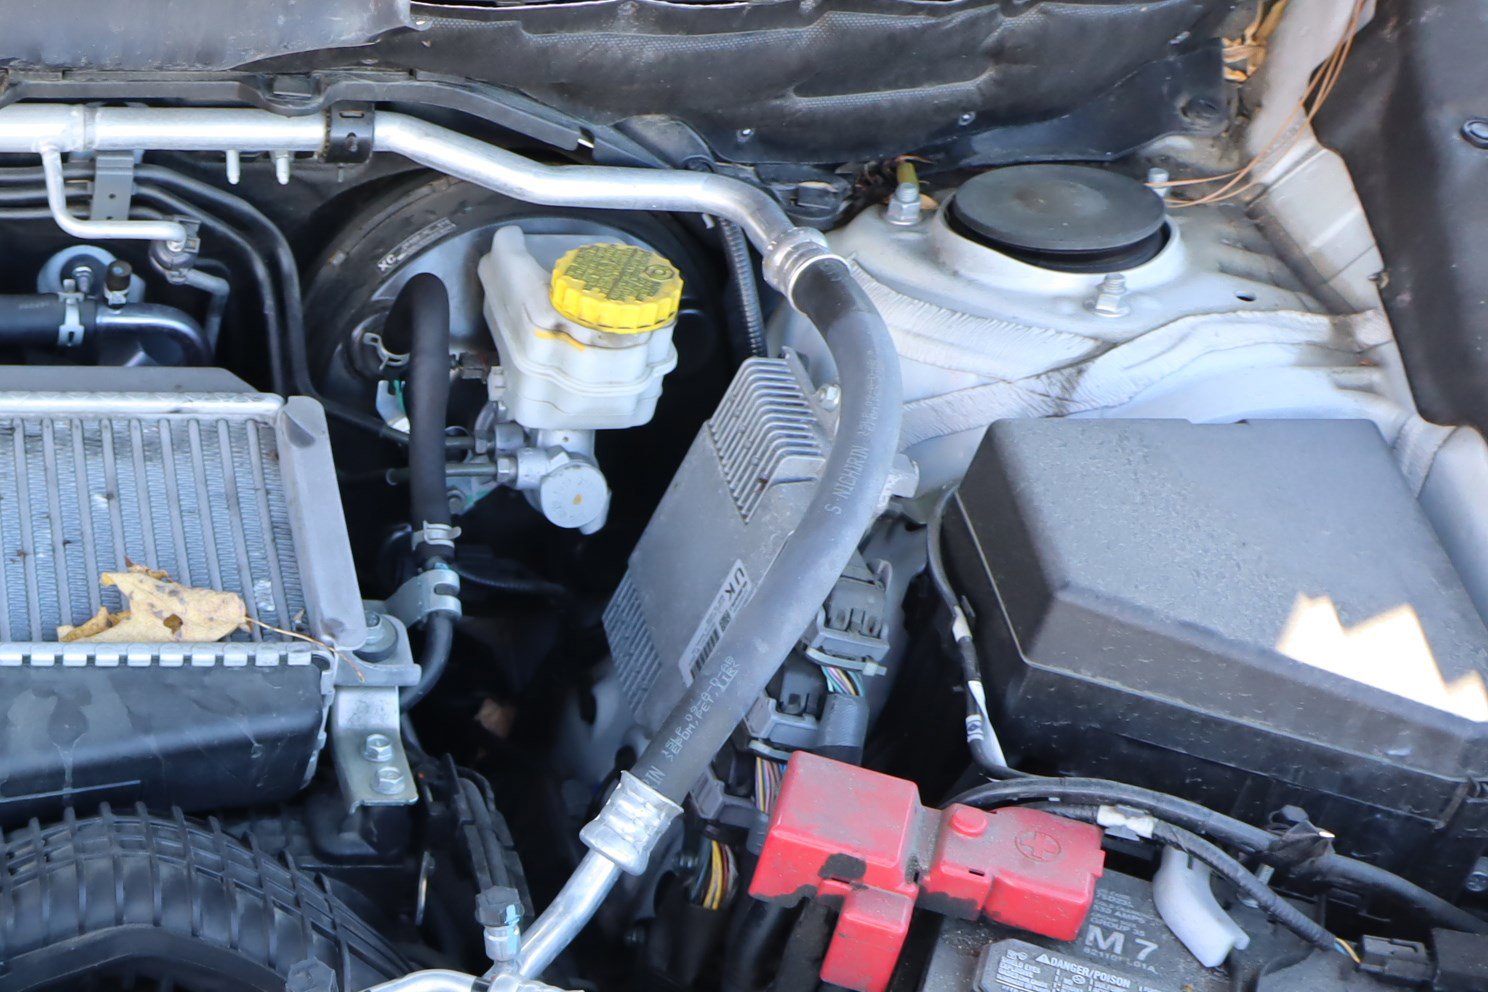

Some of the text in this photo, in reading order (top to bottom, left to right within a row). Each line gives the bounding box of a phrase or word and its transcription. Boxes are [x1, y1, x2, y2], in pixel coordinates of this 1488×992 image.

[1084, 925, 1159, 961] M 7
[1049, 957, 1131, 988] DANGER/POISON
